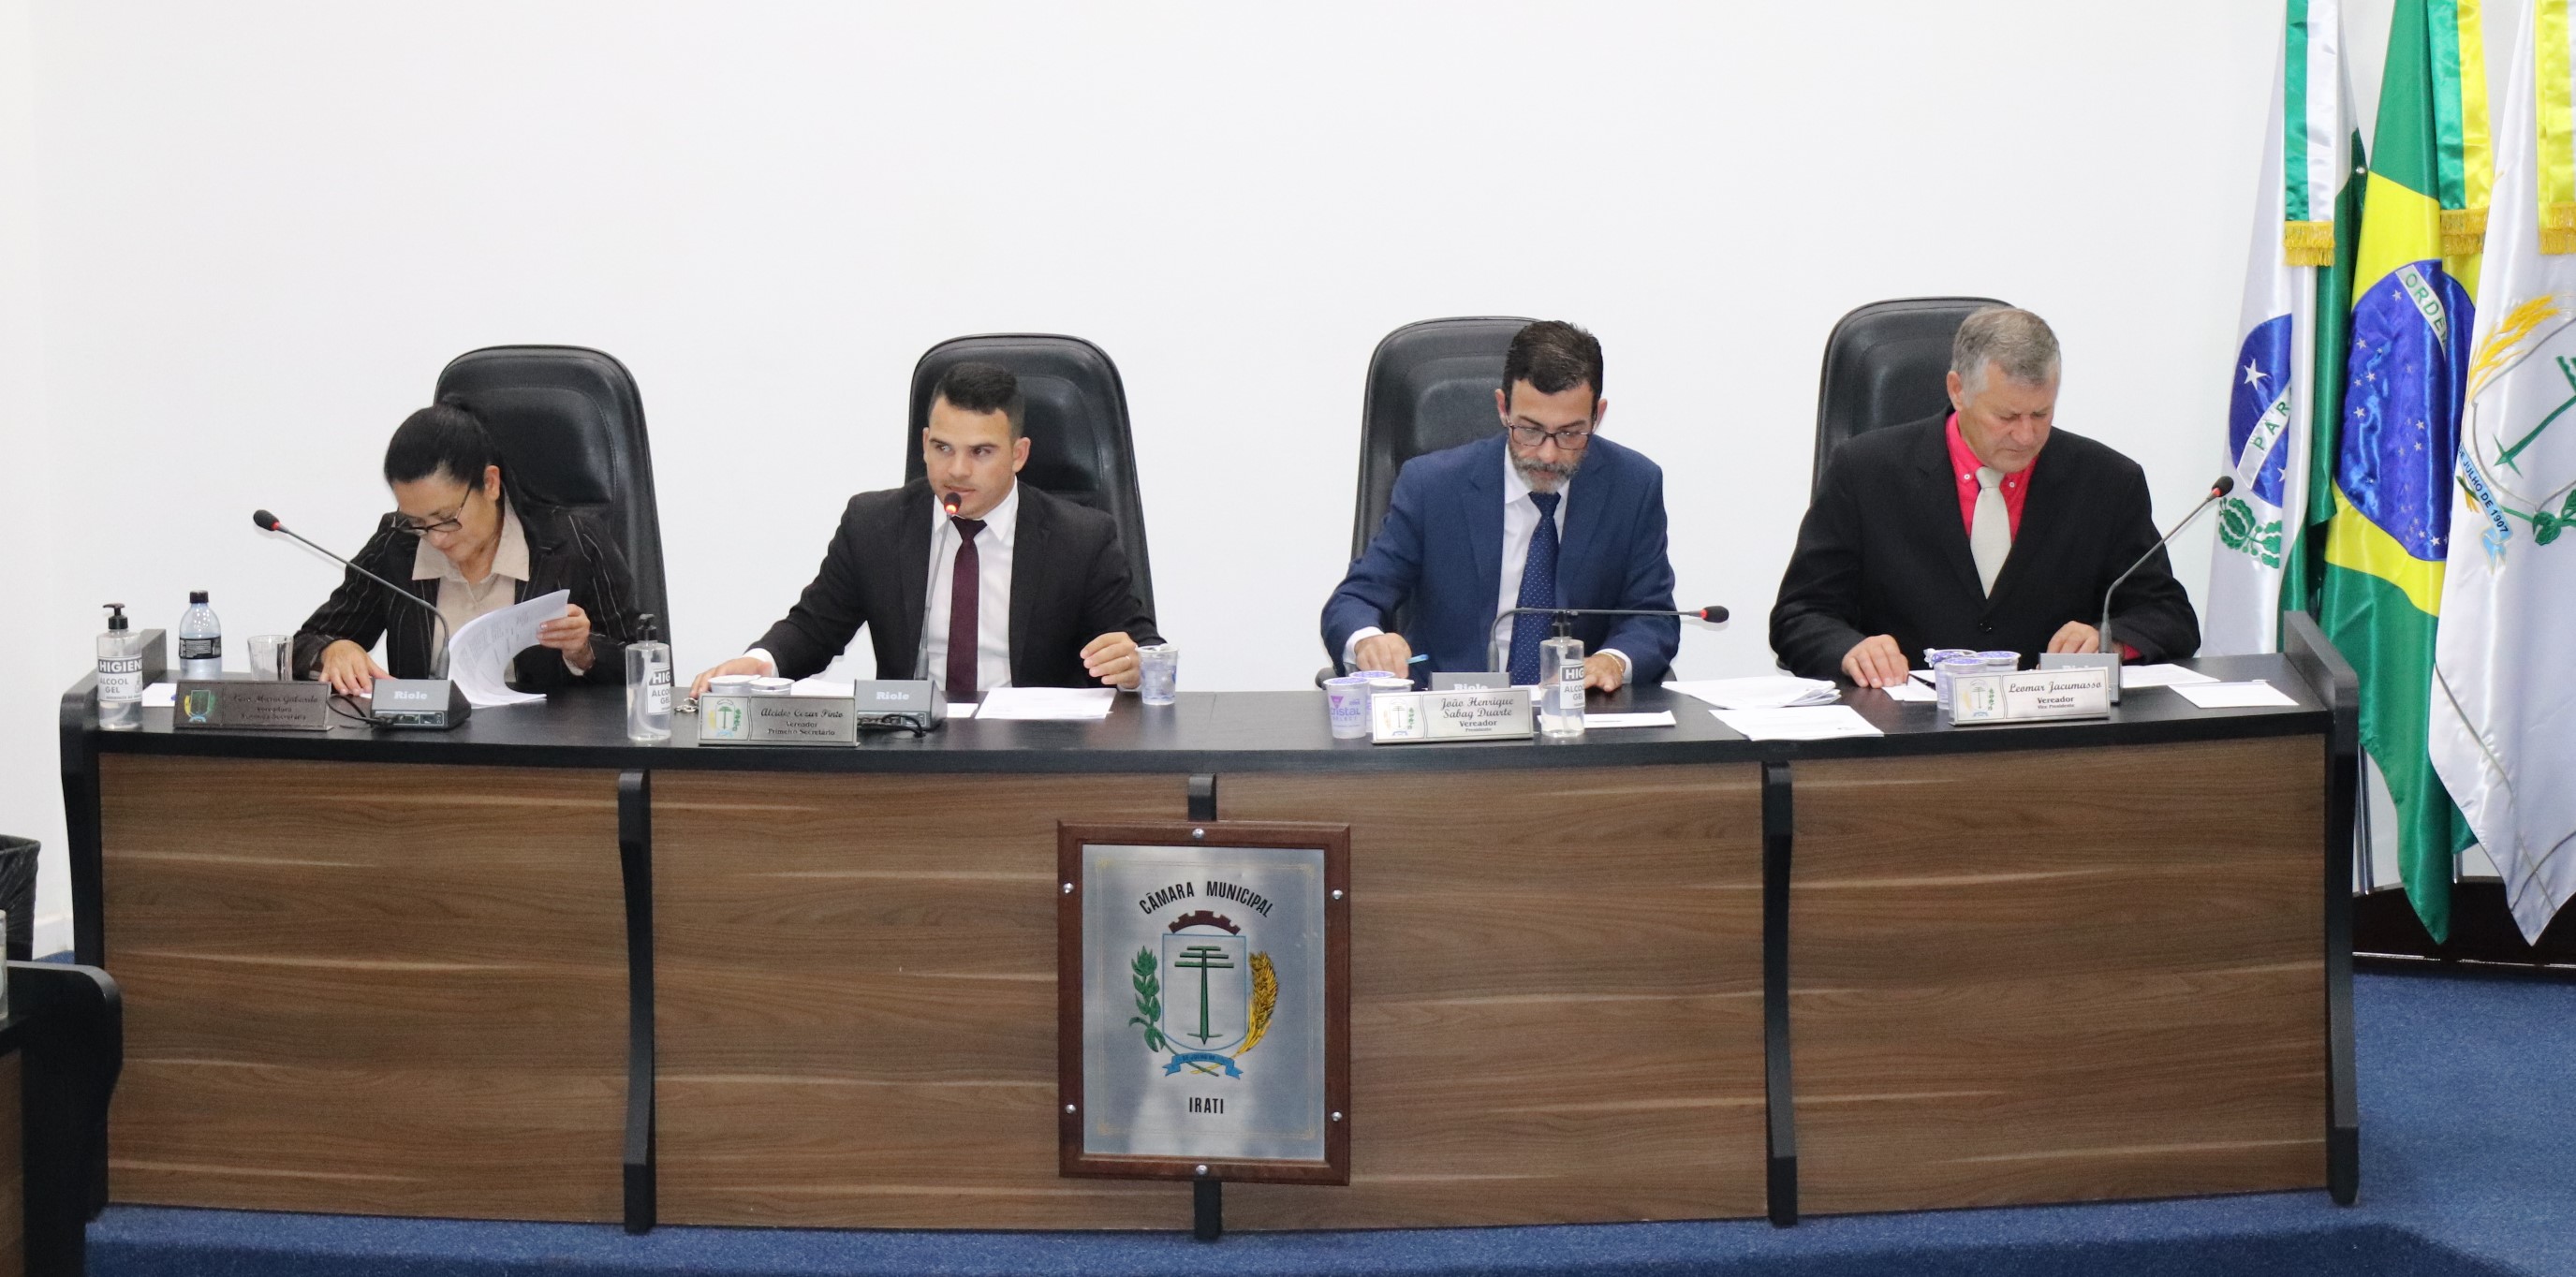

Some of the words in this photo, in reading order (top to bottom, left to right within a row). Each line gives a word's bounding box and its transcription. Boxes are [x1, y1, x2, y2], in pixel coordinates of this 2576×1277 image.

[2252, 387, 2292, 451] PAR
[2463, 461, 2483, 492] JULHO
[2480, 492, 2494, 508] DE
[2490, 509, 2510, 533] 1907
[99, 677, 129, 685] ALCOOL
[2008, 683, 2046, 693] Leomar
[2048, 681, 2102, 694] Jacumasso
[393, 690, 428, 700] Riole
[876, 691, 909, 700] Riole
[2037, 696, 2074, 704] Vereador
[1440, 697, 1465, 711] João
[1465, 697, 1514, 709] Henrique
[760, 708, 790, 717] Alcides
[820, 709, 844, 718] Pinto
[1442, 709, 1474, 722] Sabag
[1477, 708, 1512, 717] Duarte
[1206, 880, 1273, 918] MUNICIPAL
[1189, 1096, 1224, 1114] IRATI
